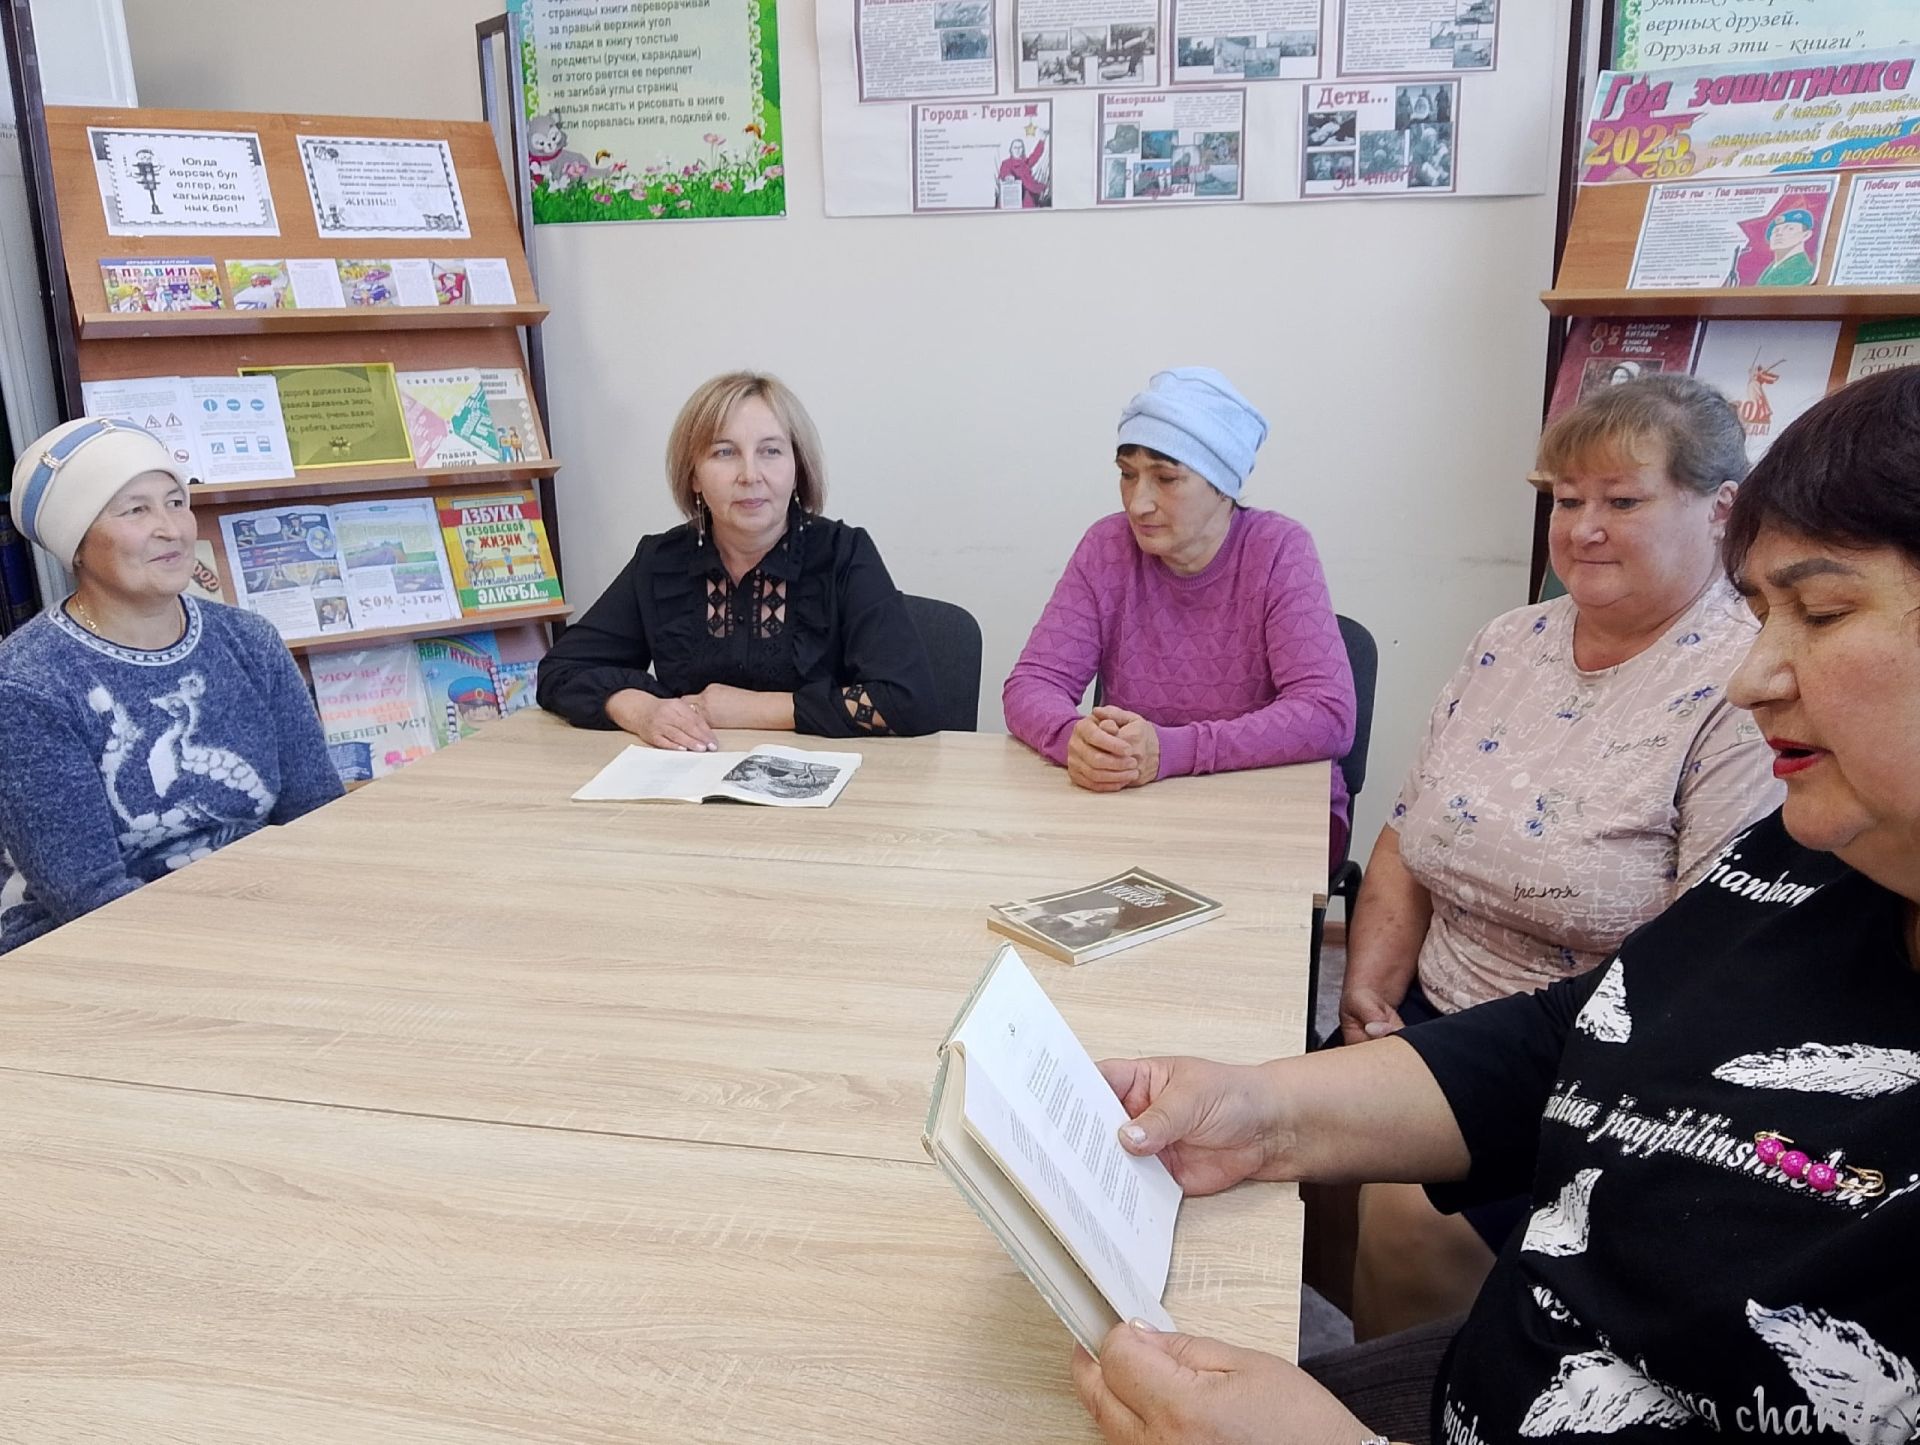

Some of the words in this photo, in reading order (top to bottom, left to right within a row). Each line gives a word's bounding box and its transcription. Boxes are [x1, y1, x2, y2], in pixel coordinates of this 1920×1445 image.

[548, 8, 598, 20] страницы
[601, 6, 628, 15] книги
[549, 26, 559, 34] за
[562, 22, 601, 35] правый
[604, 19, 645, 32] верхний
[649, 18, 671, 30] угол
[1646, 16, 1721, 35] верных
[1725, 10, 1799, 33] друзей.
[551, 42, 562, 51] не
[565, 40, 594, 51] клади
[597, 40, 602, 48] в
[606, 37, 633, 50] книгу
[635, 34, 679, 45] толстые
[1644, 41, 1721, 62] Друзья
[1727, 40, 1769, 54] эти
[551, 54, 602, 68] предметы
[604, 51, 639, 65] (ручки,
[641, 47, 702, 62] карандаши)
[552, 74, 563, 82] от
[565, 72, 593, 82] этого
[595, 69, 629, 82] рвется
[631, 68, 643, 77] ее
[645, 65, 693, 79] переплет
[554, 89, 565, 98] не
[568, 84, 606, 97] загибай
[609, 84, 634, 97] углы
[637, 83, 679, 95] страниц
[1317, 87, 1388, 109] Дети...
[1602, 74, 1673, 119] Год
[591, 102, 626, 112] писать
[629, 101, 635, 110] и
[637, 98, 685, 111] рисовать
[688, 98, 693, 106] в
[697, 95, 725, 105] книге
[1106, 95, 1166, 106] Мемориалы
[922, 108, 968, 124] Города
[981, 105, 1021, 122] Герои
[1106, 110, 1144, 119] памяти
[1773, 103, 1789, 121] в
[582, 117, 635, 131] порвалась
[637, 115, 668, 126] книга,
[670, 111, 713, 124] подклей
[715, 112, 730, 121] ее.
[1709, 122, 1825, 149] специальной
[1827, 115, 1907, 144] военной
[1584, 121, 1693, 165] 2025
[1641, 152, 1696, 178] год
[1739, 147, 1813, 166] память
[1821, 151, 1831, 163] о
[1715, 187, 1730, 198] Год
[1863, 179, 1900, 191] Победу
[122, 267, 200, 278] ПРАВИЛА
[1862, 344, 1913, 363] ДОЛГ
[437, 450, 478, 461] Главная
[461, 504, 523, 525] АЗБУКА
[466, 521, 526, 537] БЕЗОПАСНОЙ
[480, 533, 522, 549] ЖИЗНИ
